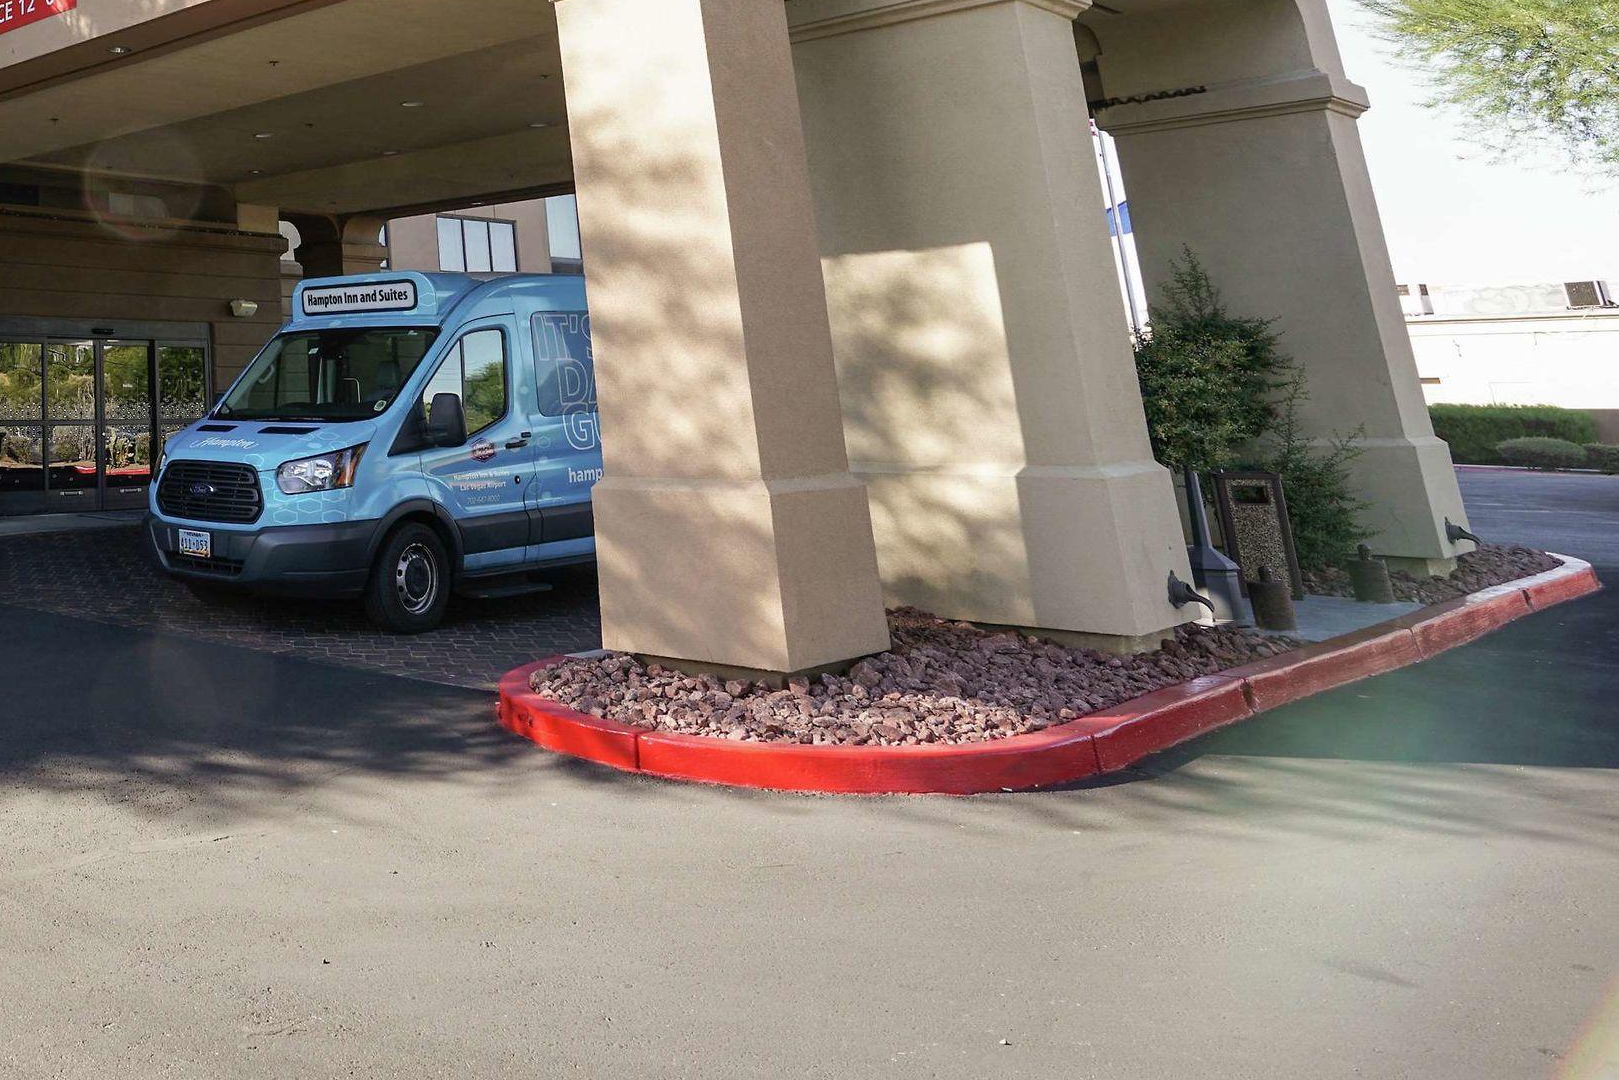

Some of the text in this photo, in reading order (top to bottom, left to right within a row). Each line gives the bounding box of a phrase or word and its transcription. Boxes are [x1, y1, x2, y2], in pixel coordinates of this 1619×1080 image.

[307, 288, 408, 308] Hampton Inn and Suites
[189, 436, 259, 449] Hampton
